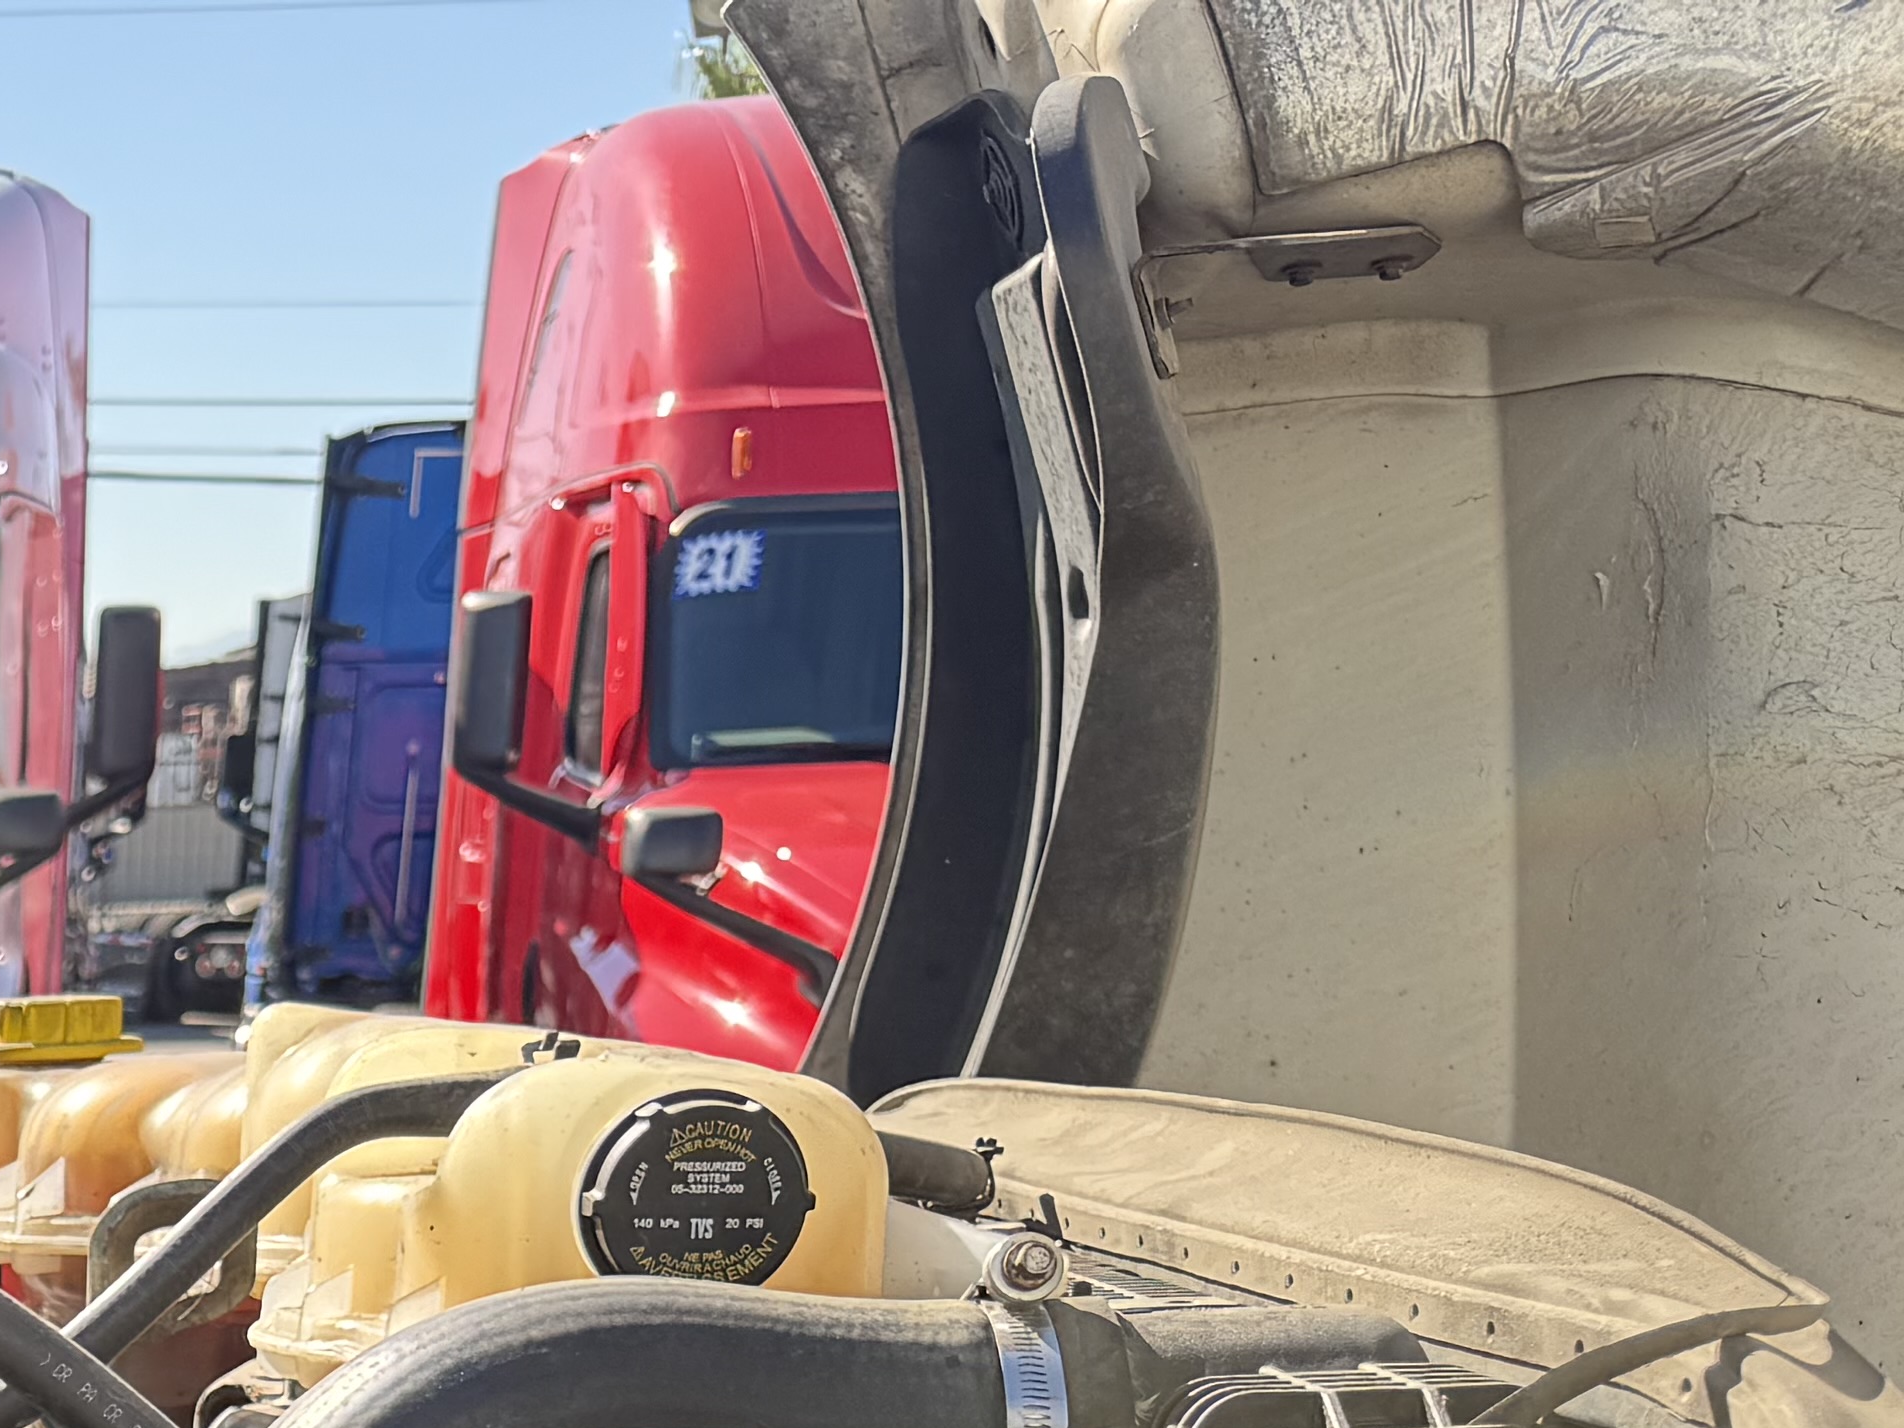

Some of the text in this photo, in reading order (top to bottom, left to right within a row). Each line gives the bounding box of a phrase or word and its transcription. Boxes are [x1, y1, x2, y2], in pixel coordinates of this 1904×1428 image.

[685, 1120, 753, 1143] CAUTION
[665, 1138, 702, 1163] NEVER
[704, 1137, 736, 1153] OPEN
[672, 1161, 746, 1172] PRESSURIZED
[687, 1173, 730, 1183] SYSTEM
[633, 1218, 653, 1228] 140
[690, 1218, 714, 1239] TVS
[725, 1218, 764, 1228] 20 PSI
[711, 1243, 753, 1270] CHAUD
